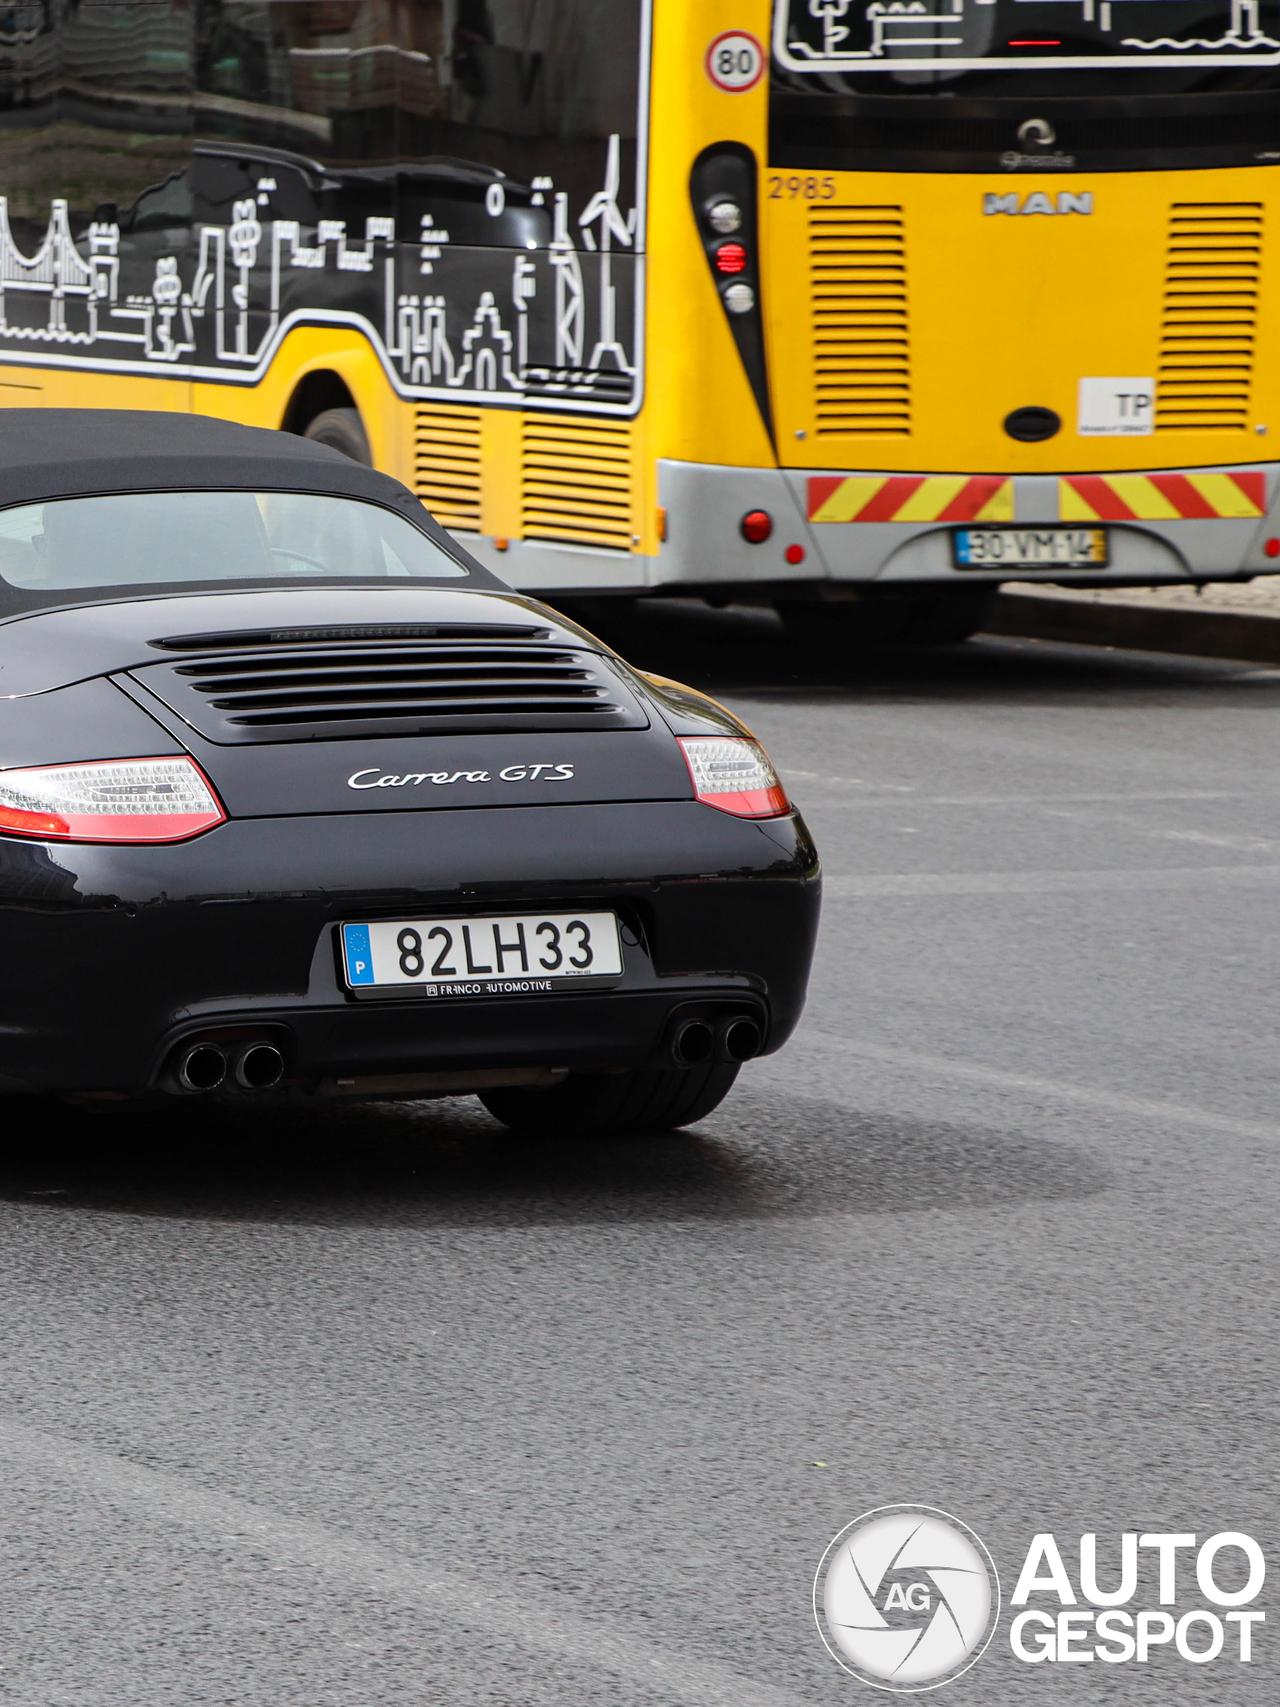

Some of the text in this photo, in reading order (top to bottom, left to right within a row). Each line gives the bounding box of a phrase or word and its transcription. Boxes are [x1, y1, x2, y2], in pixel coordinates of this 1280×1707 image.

[718, 49, 753, 75] 80
[768, 176, 837, 200] 2985
[983, 191, 1093, 216] MAN
[1115, 393, 1151, 417] TP
[347, 763, 575, 790] Carrera GTS
[355, 919, 594, 978] P 82LH33
[440, 983, 481, 995] FRANCO
[485, 980, 553, 994] AUTOMOTIVE
